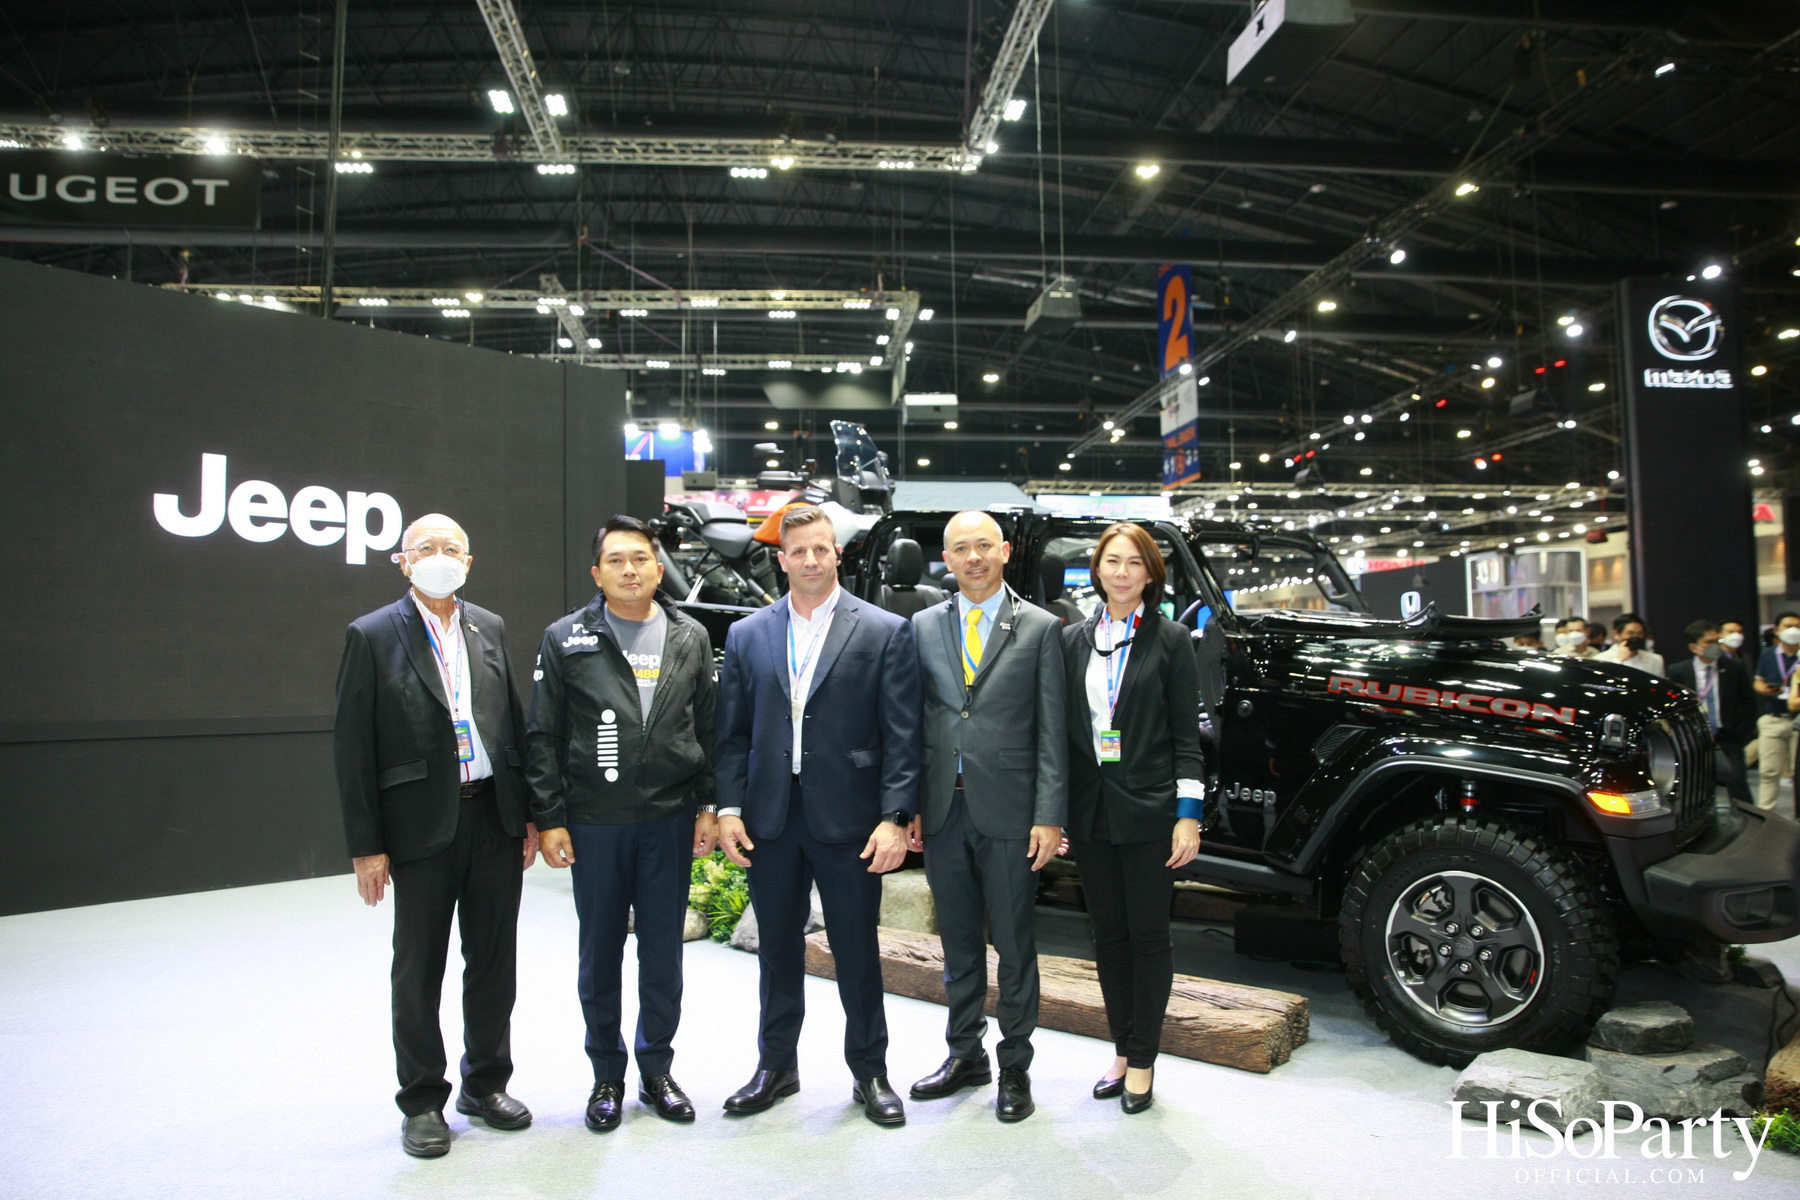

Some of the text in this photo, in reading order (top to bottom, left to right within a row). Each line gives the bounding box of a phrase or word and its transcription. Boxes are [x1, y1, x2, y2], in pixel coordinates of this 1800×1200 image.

[9, 173, 229, 206] UGEOT
[1163, 274, 1189, 371] 2
[153, 452, 403, 566] Jeep
[562, 635, 598, 648] Jeep
[1327, 676, 1576, 725] RUBICON
[1226, 782, 1277, 808] Jeep
